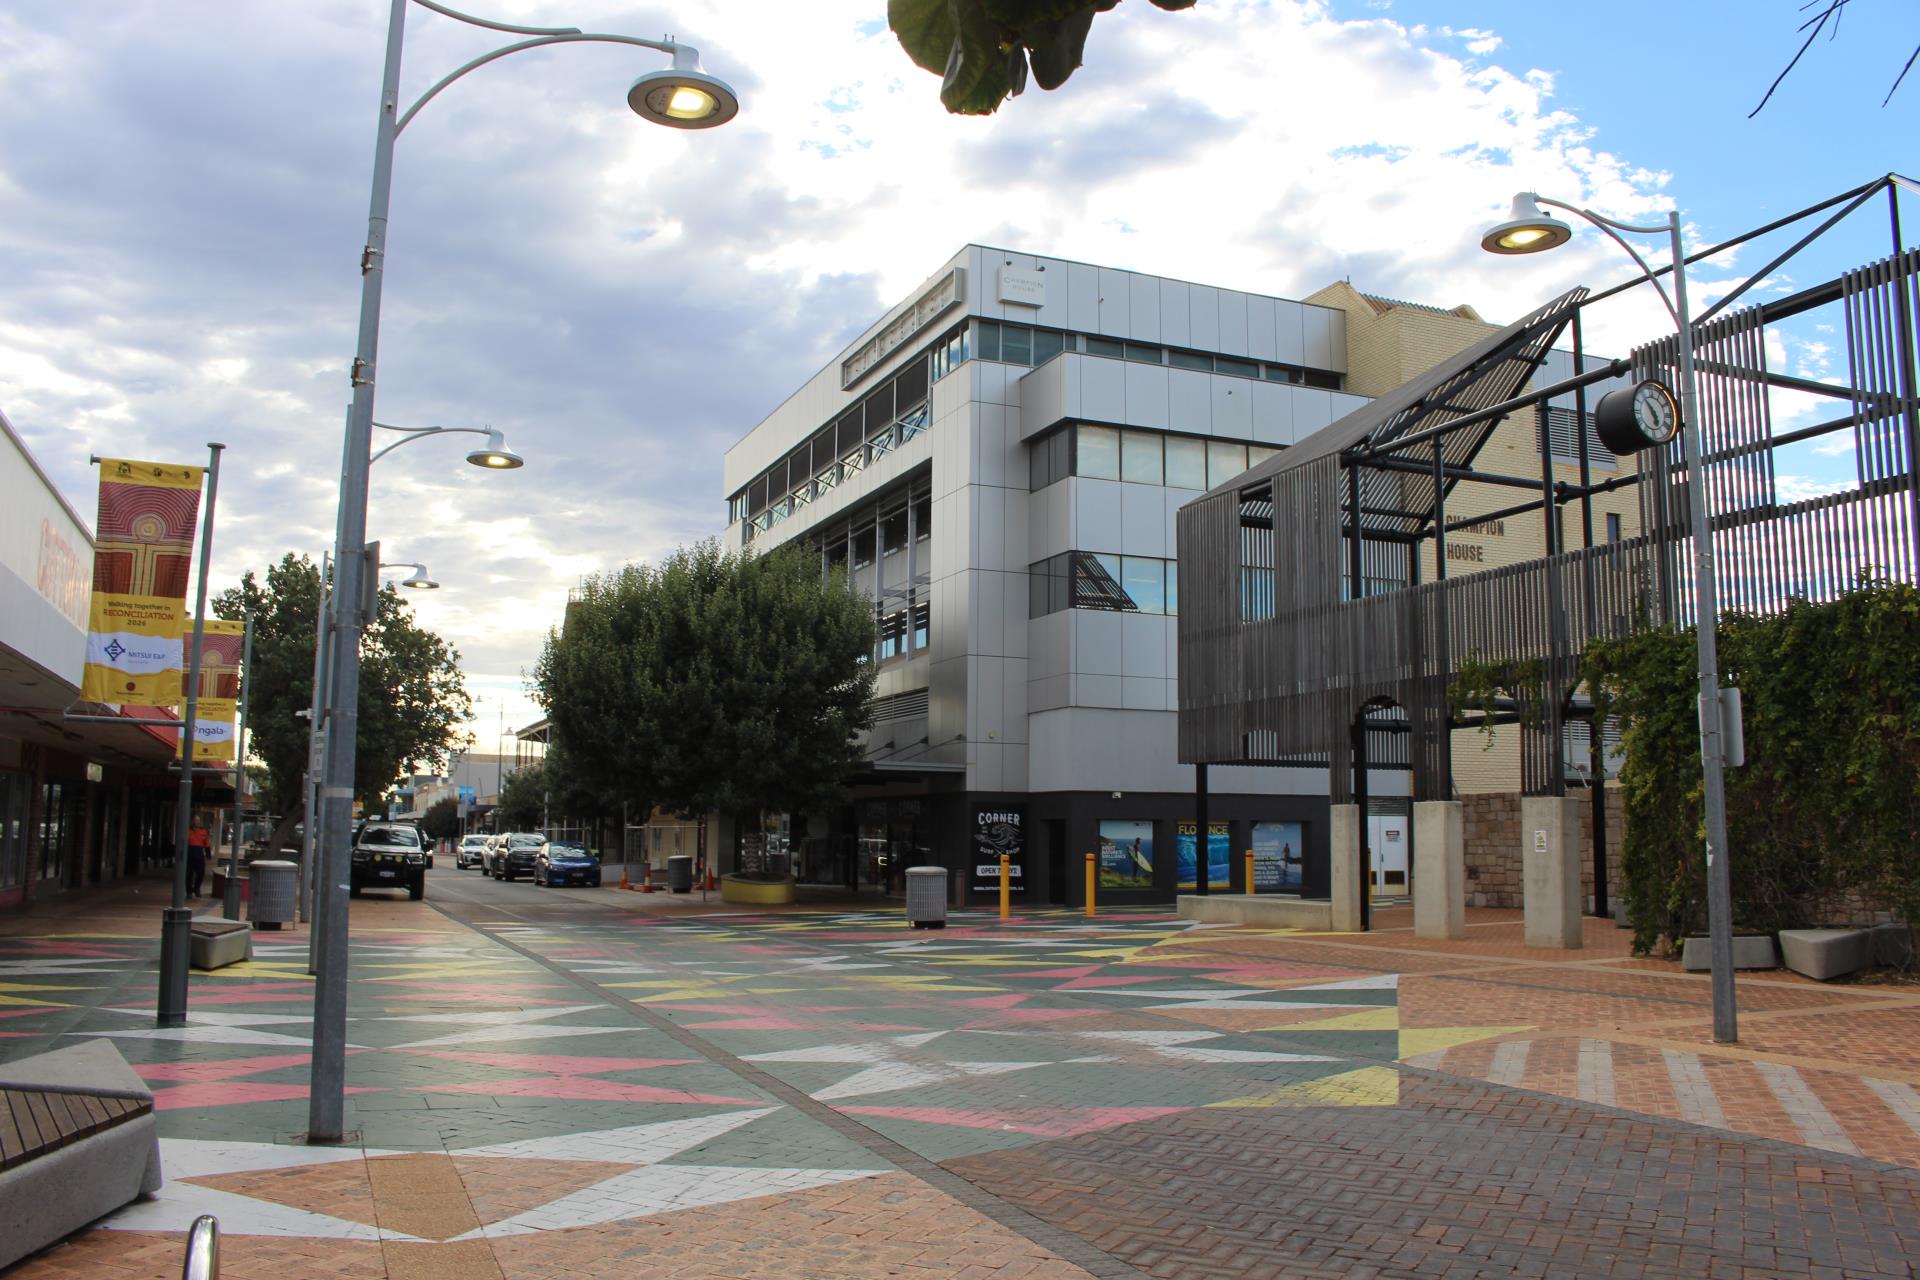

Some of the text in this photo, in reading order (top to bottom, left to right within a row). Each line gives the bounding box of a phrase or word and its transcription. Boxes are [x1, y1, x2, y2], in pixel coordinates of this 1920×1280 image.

[1446, 543, 1483, 562] HOUSE
[108, 601, 132, 609] Walking
[134, 603, 163, 611] together
[104, 609, 174, 621] RECONCILIATION
[198, 727, 224, 736] ngala
[978, 812, 1020, 825] CORNER
[1178, 825, 1229, 835] FLONCE
